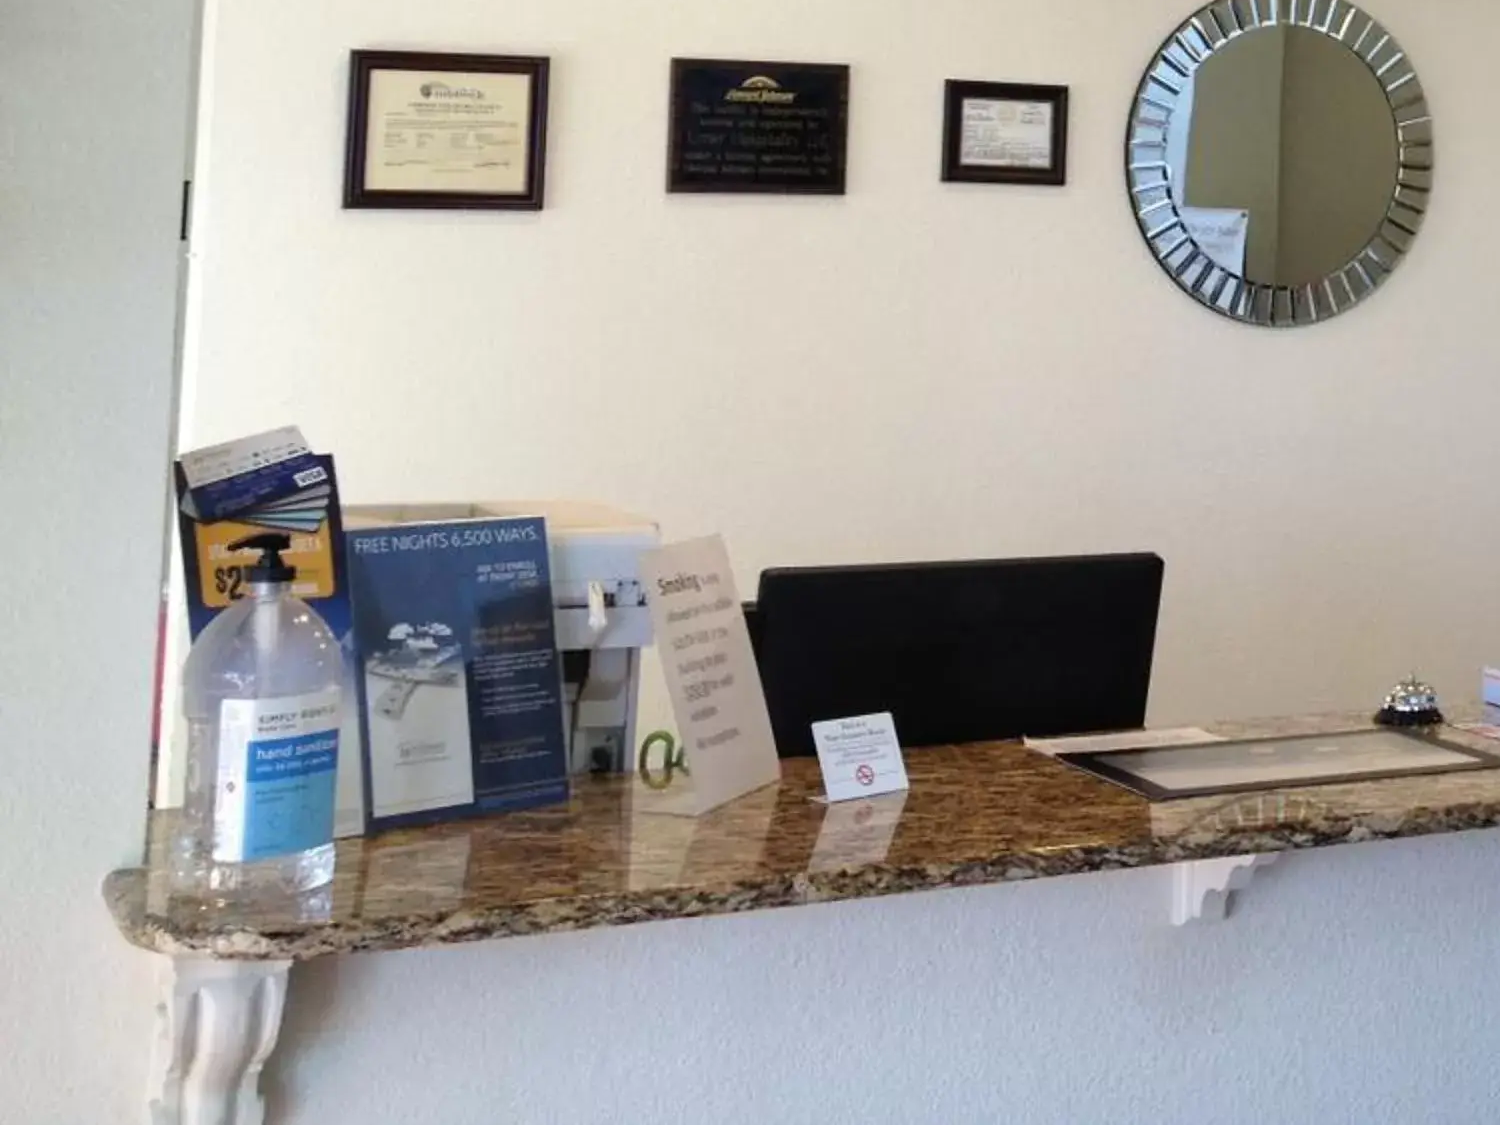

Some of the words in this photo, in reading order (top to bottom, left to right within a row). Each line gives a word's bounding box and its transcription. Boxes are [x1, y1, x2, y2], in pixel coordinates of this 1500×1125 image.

[353, 536, 389, 555] FREE
[393, 531, 449, 552] NIGHTS
[451, 529, 493, 549] 6,500
[656, 571, 703, 596] Smoking
[255, 744, 294, 761] hand
